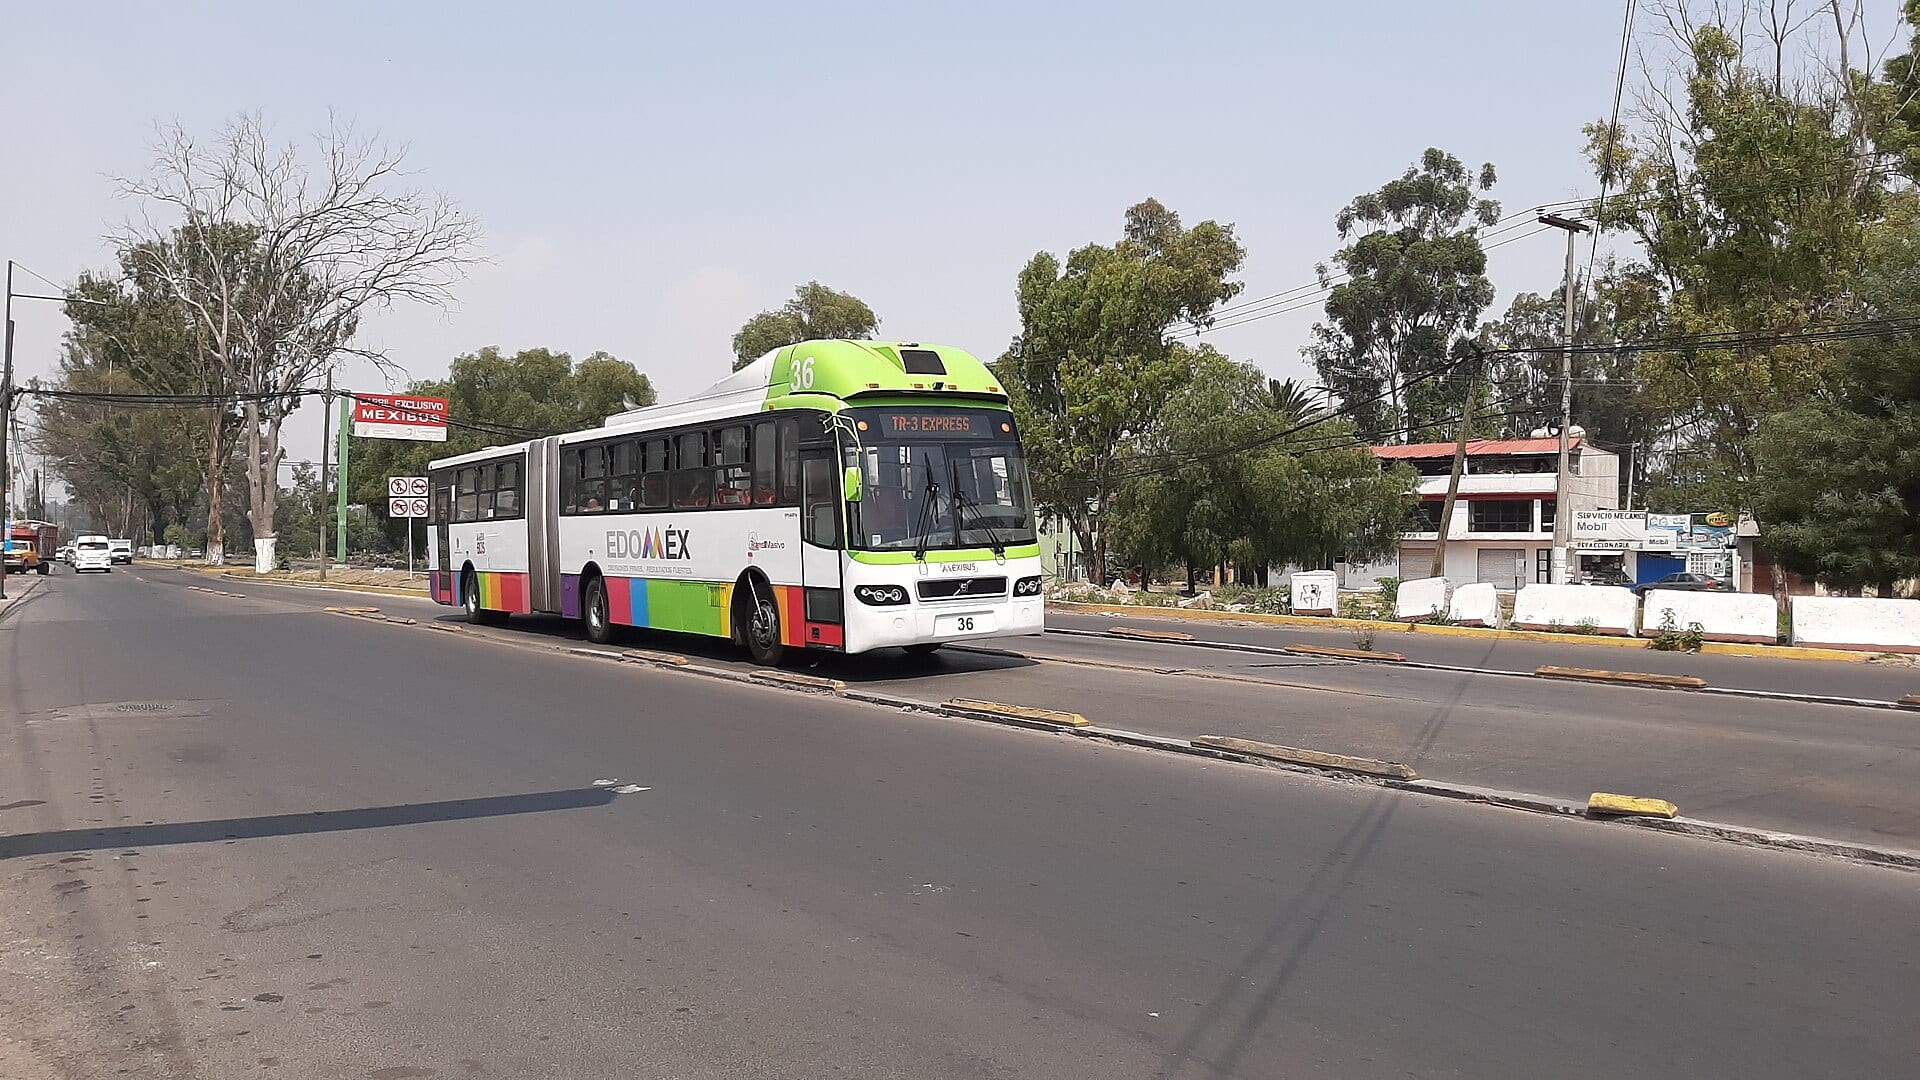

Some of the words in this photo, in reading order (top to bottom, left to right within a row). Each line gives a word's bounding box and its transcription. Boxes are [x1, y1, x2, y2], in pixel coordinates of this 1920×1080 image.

[790, 356, 816, 391] 36
[394, 399, 444, 411] EXCLUSIVO
[361, 409, 440, 423] MEXIBUS
[891, 416, 918, 431] TR-3
[921, 416, 970, 431] EXPRESS
[1577, 522, 1607, 531] Mobil
[606, 524, 691, 560] EDOMÉX
[957, 617, 974, 631] 36
